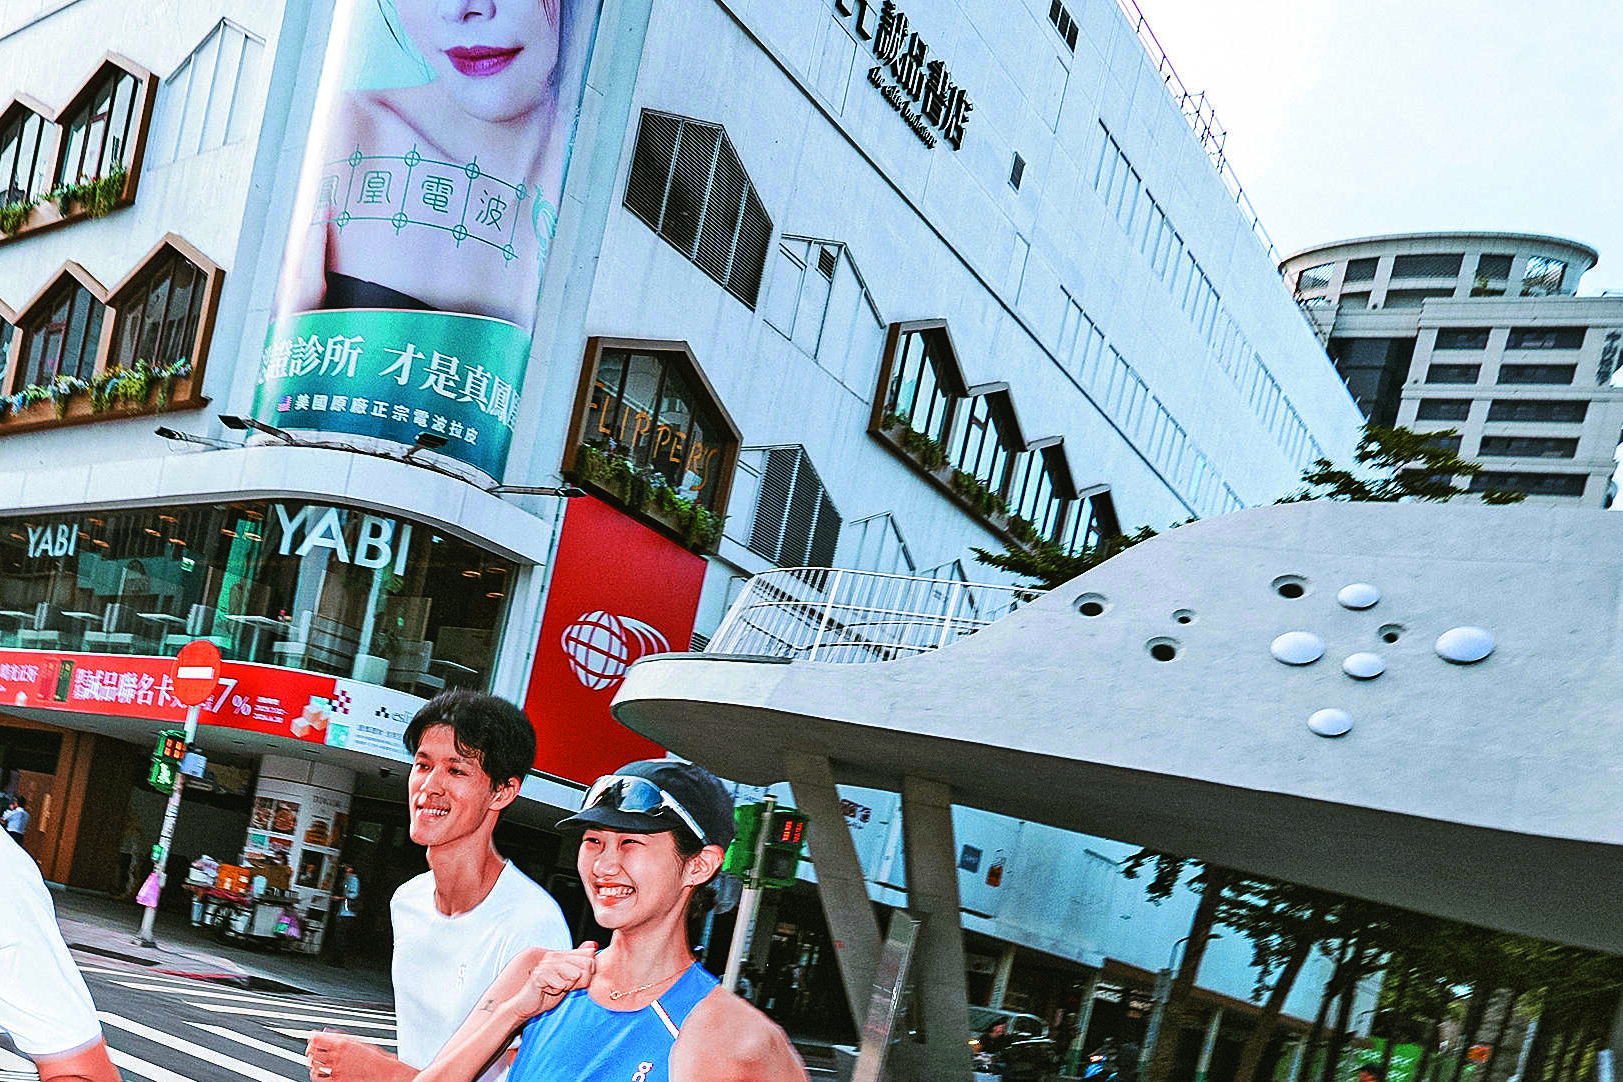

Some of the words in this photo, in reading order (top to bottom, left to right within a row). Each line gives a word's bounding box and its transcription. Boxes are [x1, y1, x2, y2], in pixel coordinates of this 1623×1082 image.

[873, 0, 973, 151] 誠品書店
[294, 393, 480, 446] 美國原廠正宗電波拉皮
[26, 523, 78, 558] YABI
[275, 503, 413, 577] YABI
